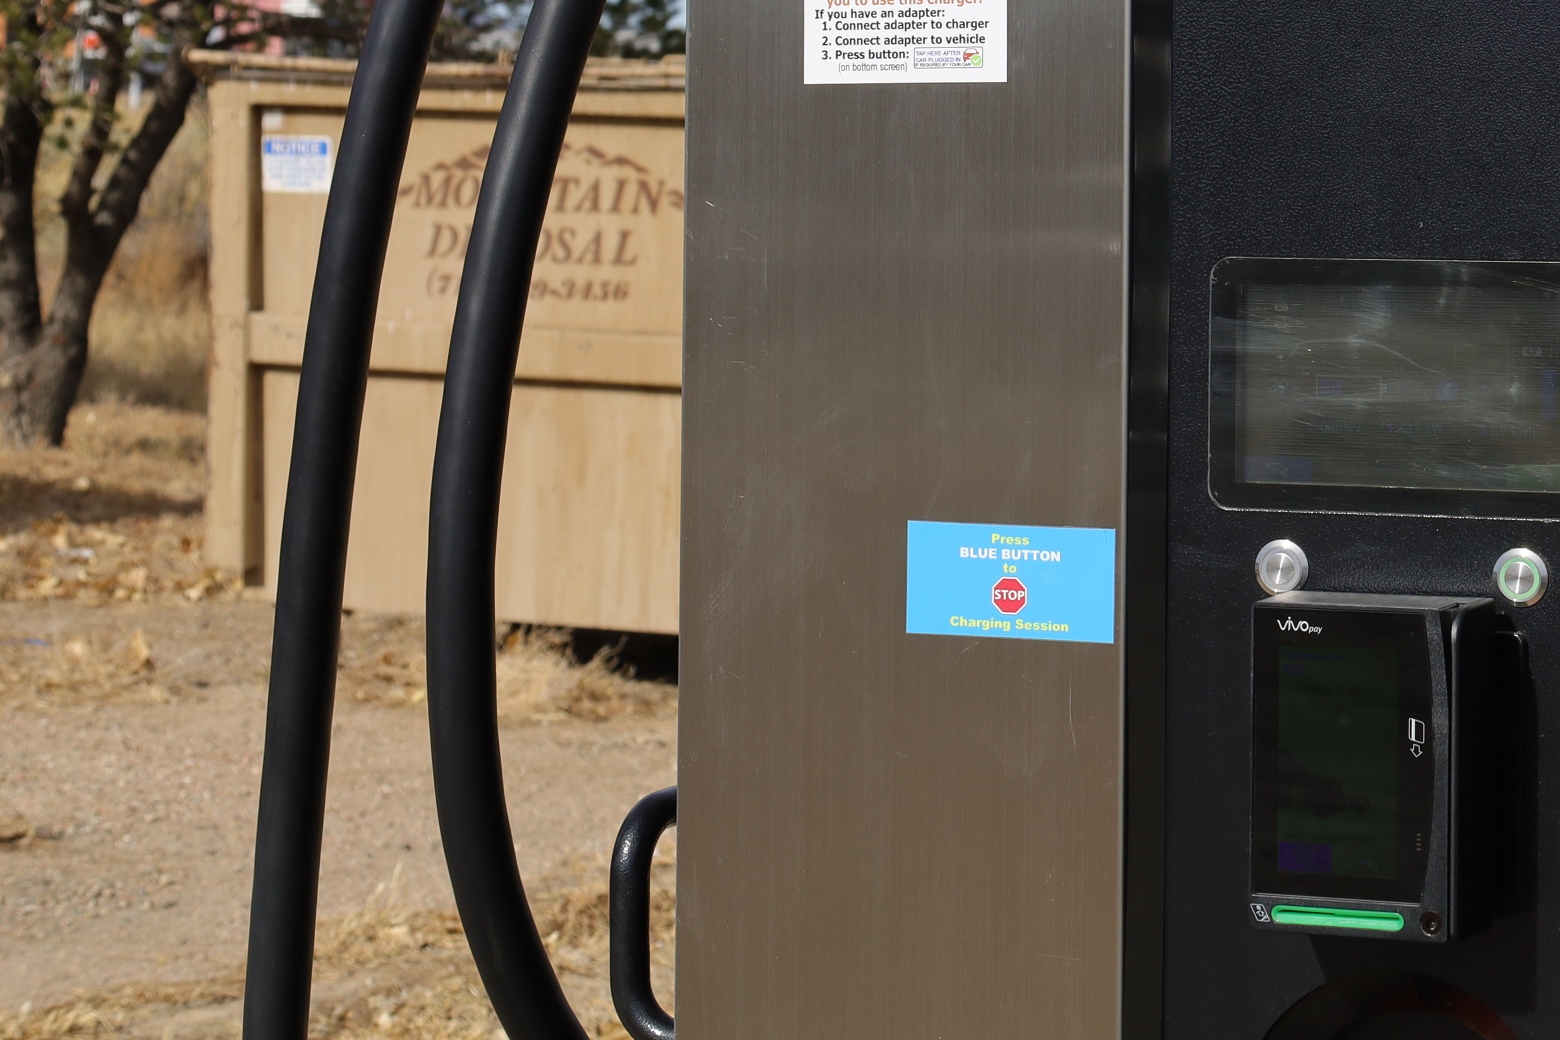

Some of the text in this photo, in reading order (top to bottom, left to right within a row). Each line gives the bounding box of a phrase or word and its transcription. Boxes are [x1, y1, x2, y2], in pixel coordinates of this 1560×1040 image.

[815, 8, 945, 22] If you have an adapter:
[822, 19, 989, 32] 1. Connect adapter to charger
[822, 34, 985, 47] 2. Connect adapter to vehicle
[821, 50, 909, 60] 3. Press button:
[838, 61, 908, 73] (on bottom screen)
[412, 171, 673, 216] MOTAIN
[991, 533, 1029, 546] Press
[959, 547, 1061, 562] BLUE BUTTON
[1003, 563, 1017, 573] to
[994, 590, 1025, 600] STOP
[950, 616, 1069, 632] Charging Session
